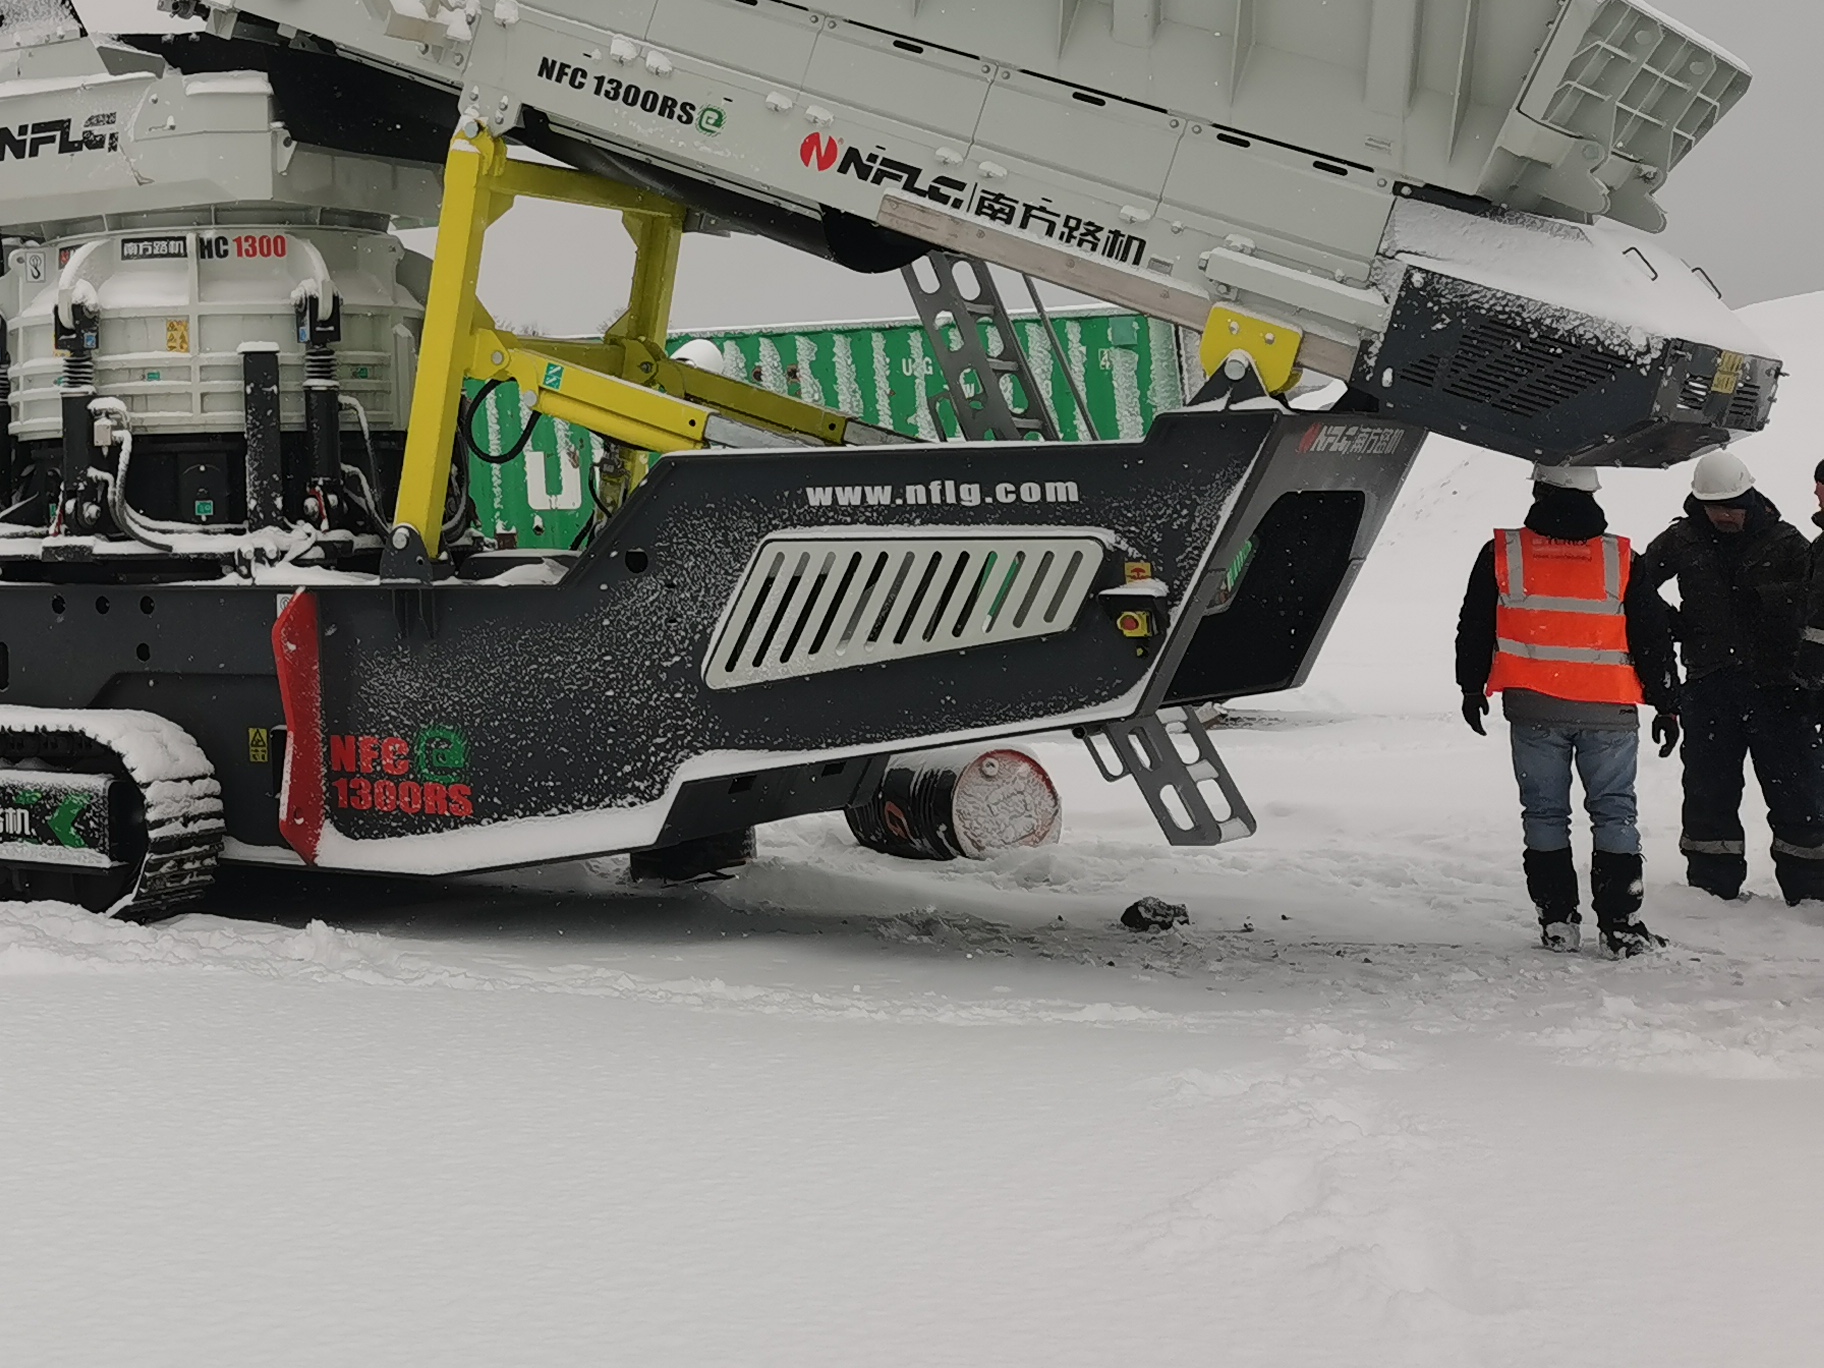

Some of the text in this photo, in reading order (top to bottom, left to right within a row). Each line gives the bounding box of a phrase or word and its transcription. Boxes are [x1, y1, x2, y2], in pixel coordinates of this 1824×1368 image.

[537, 56, 696, 125] NFC 1300RS
[233, 235, 287, 258] 1300
[975, 189, 1147, 266] 南方路机
[805, 480, 1079, 507] www.nflg.com
[330, 735, 409, 775] NFC
[332, 777, 473, 817] 1300RS
